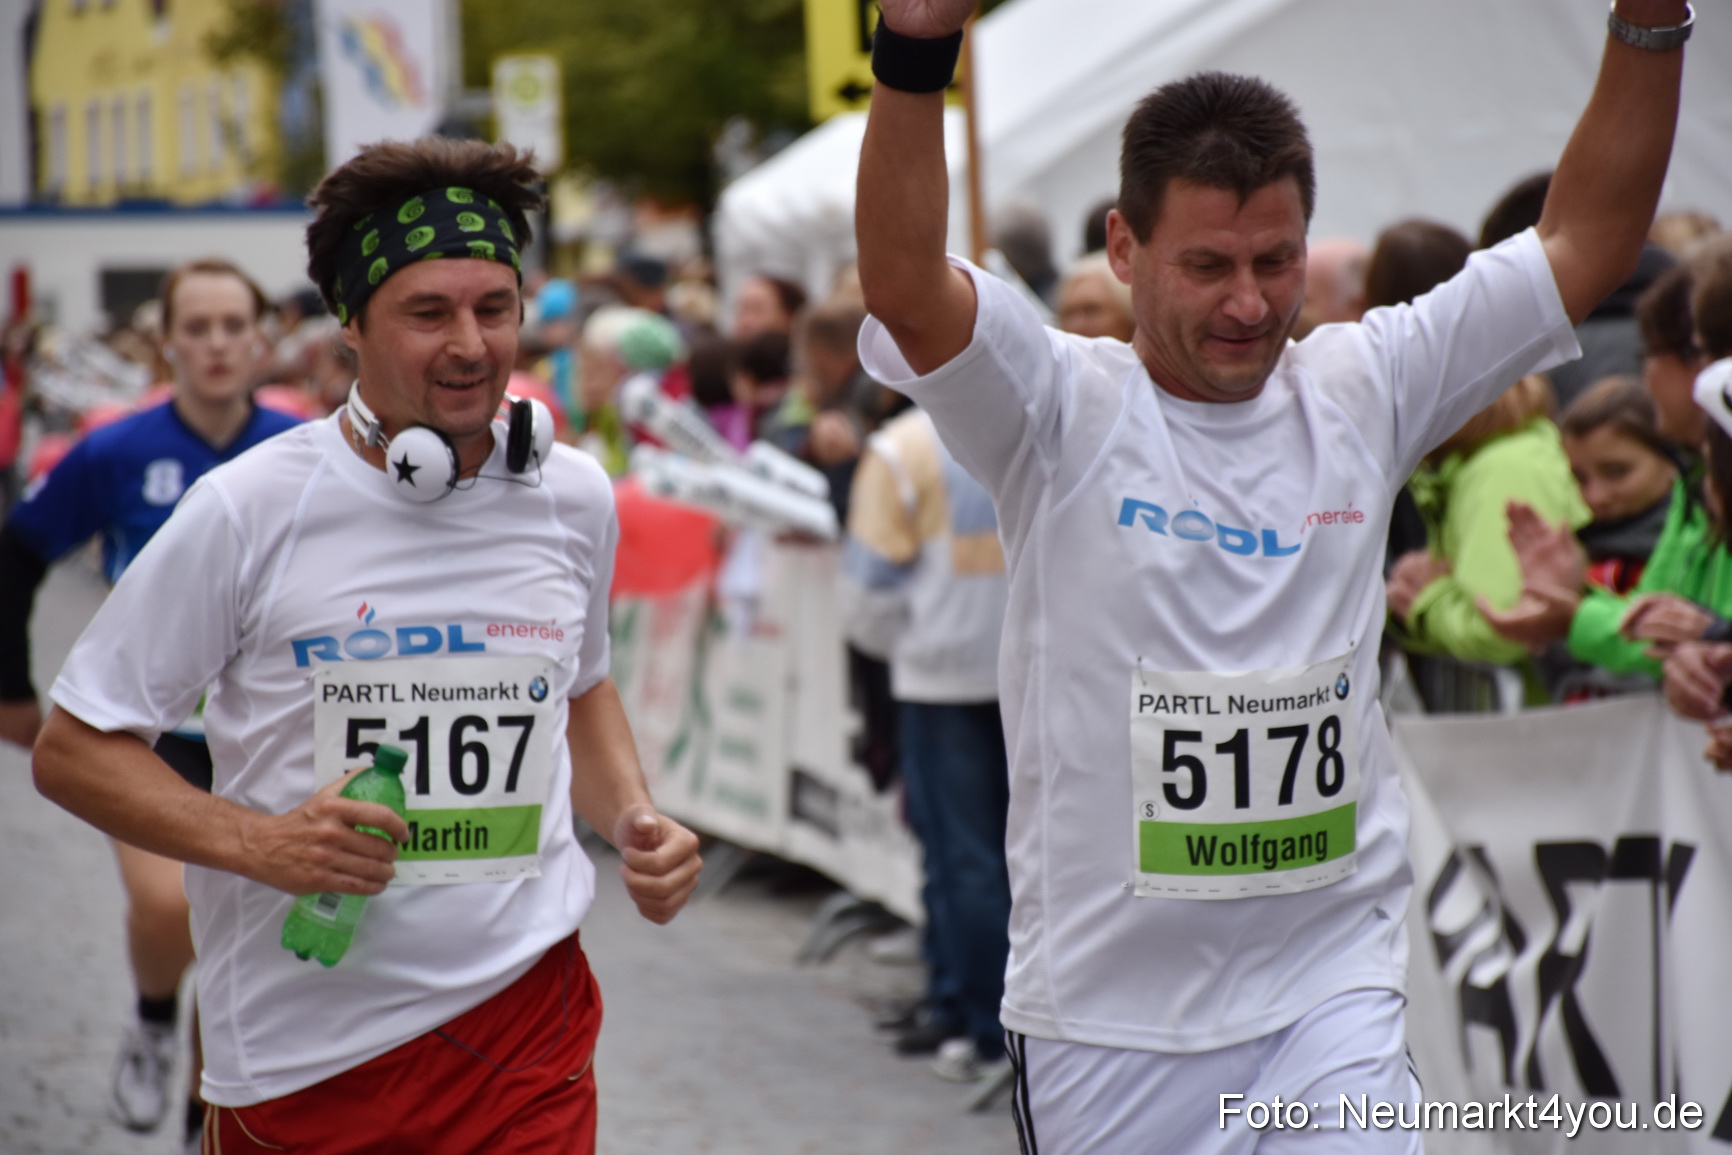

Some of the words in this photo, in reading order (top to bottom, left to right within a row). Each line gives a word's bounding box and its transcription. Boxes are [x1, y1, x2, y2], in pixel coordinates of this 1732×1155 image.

[322, 683, 405, 703] PARTL
[411, 681, 519, 702] Neumarkt
[1138, 694, 1221, 715] PARTL
[1228, 686, 1330, 714] Neumarkt
[1162, 714, 1345, 811] 5178
[1185, 829, 1328, 871] Wolfgang
